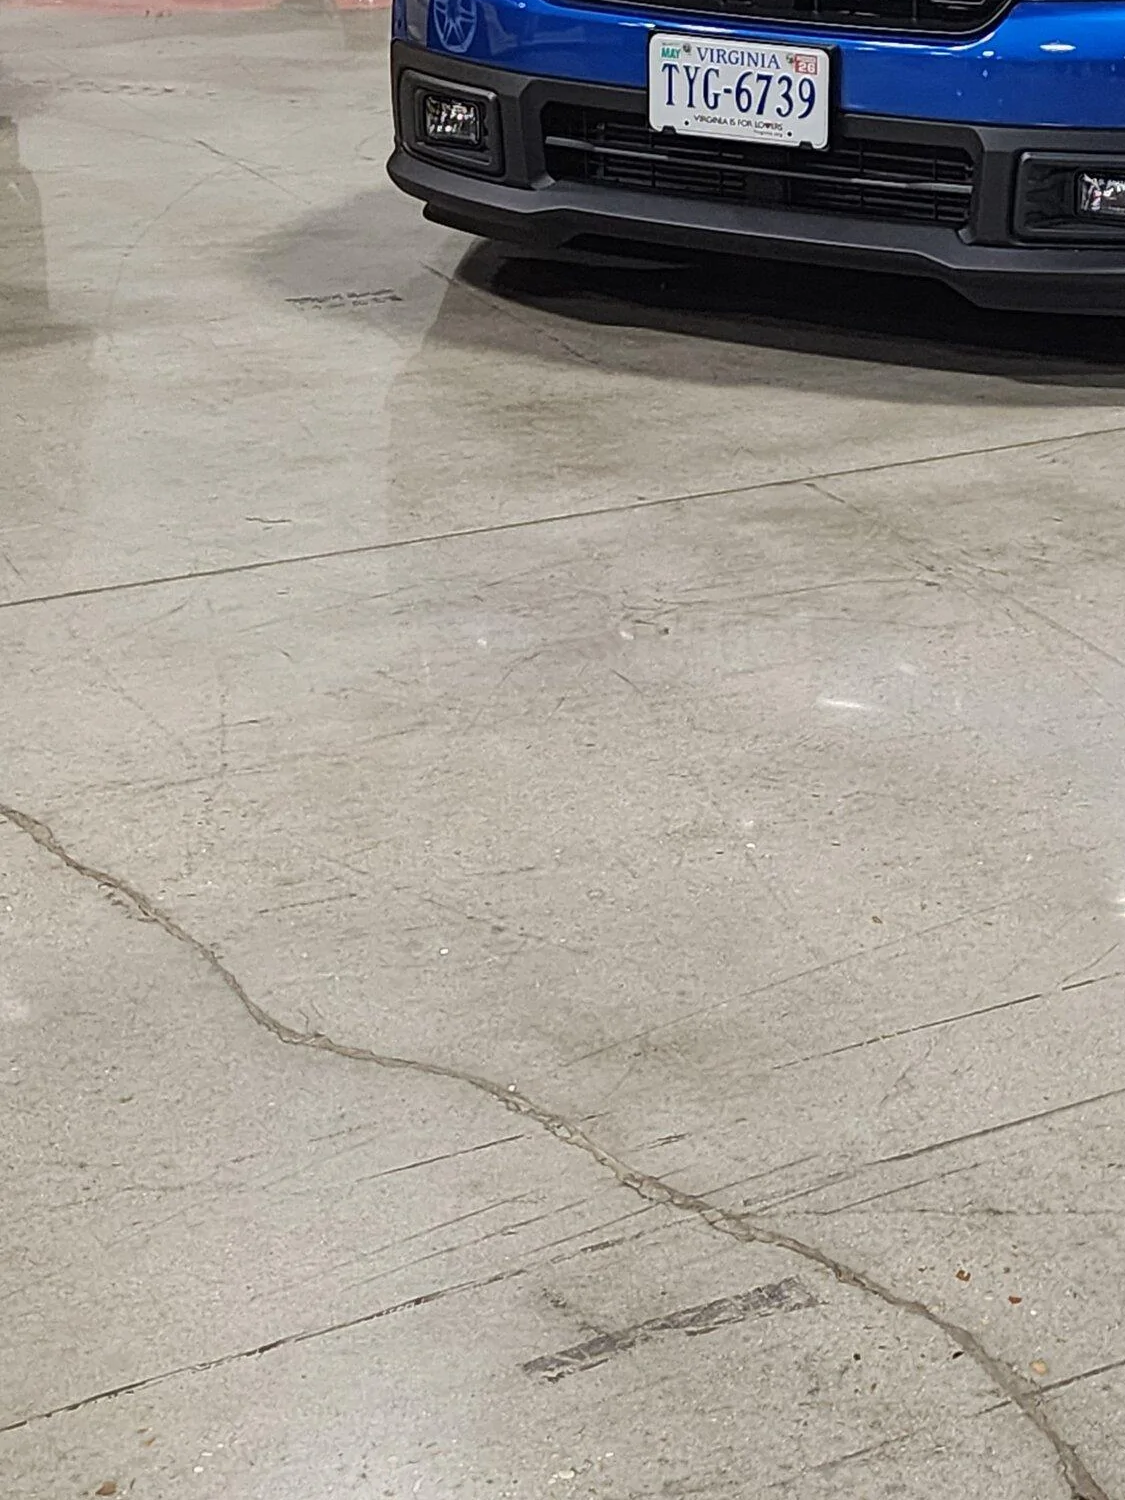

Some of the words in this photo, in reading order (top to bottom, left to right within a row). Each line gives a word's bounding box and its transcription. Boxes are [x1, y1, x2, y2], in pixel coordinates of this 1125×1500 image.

[661, 47, 680, 59] MAY
[696, 46, 781, 70] VIRGINIA
[661, 62, 817, 119] TYG-6739
